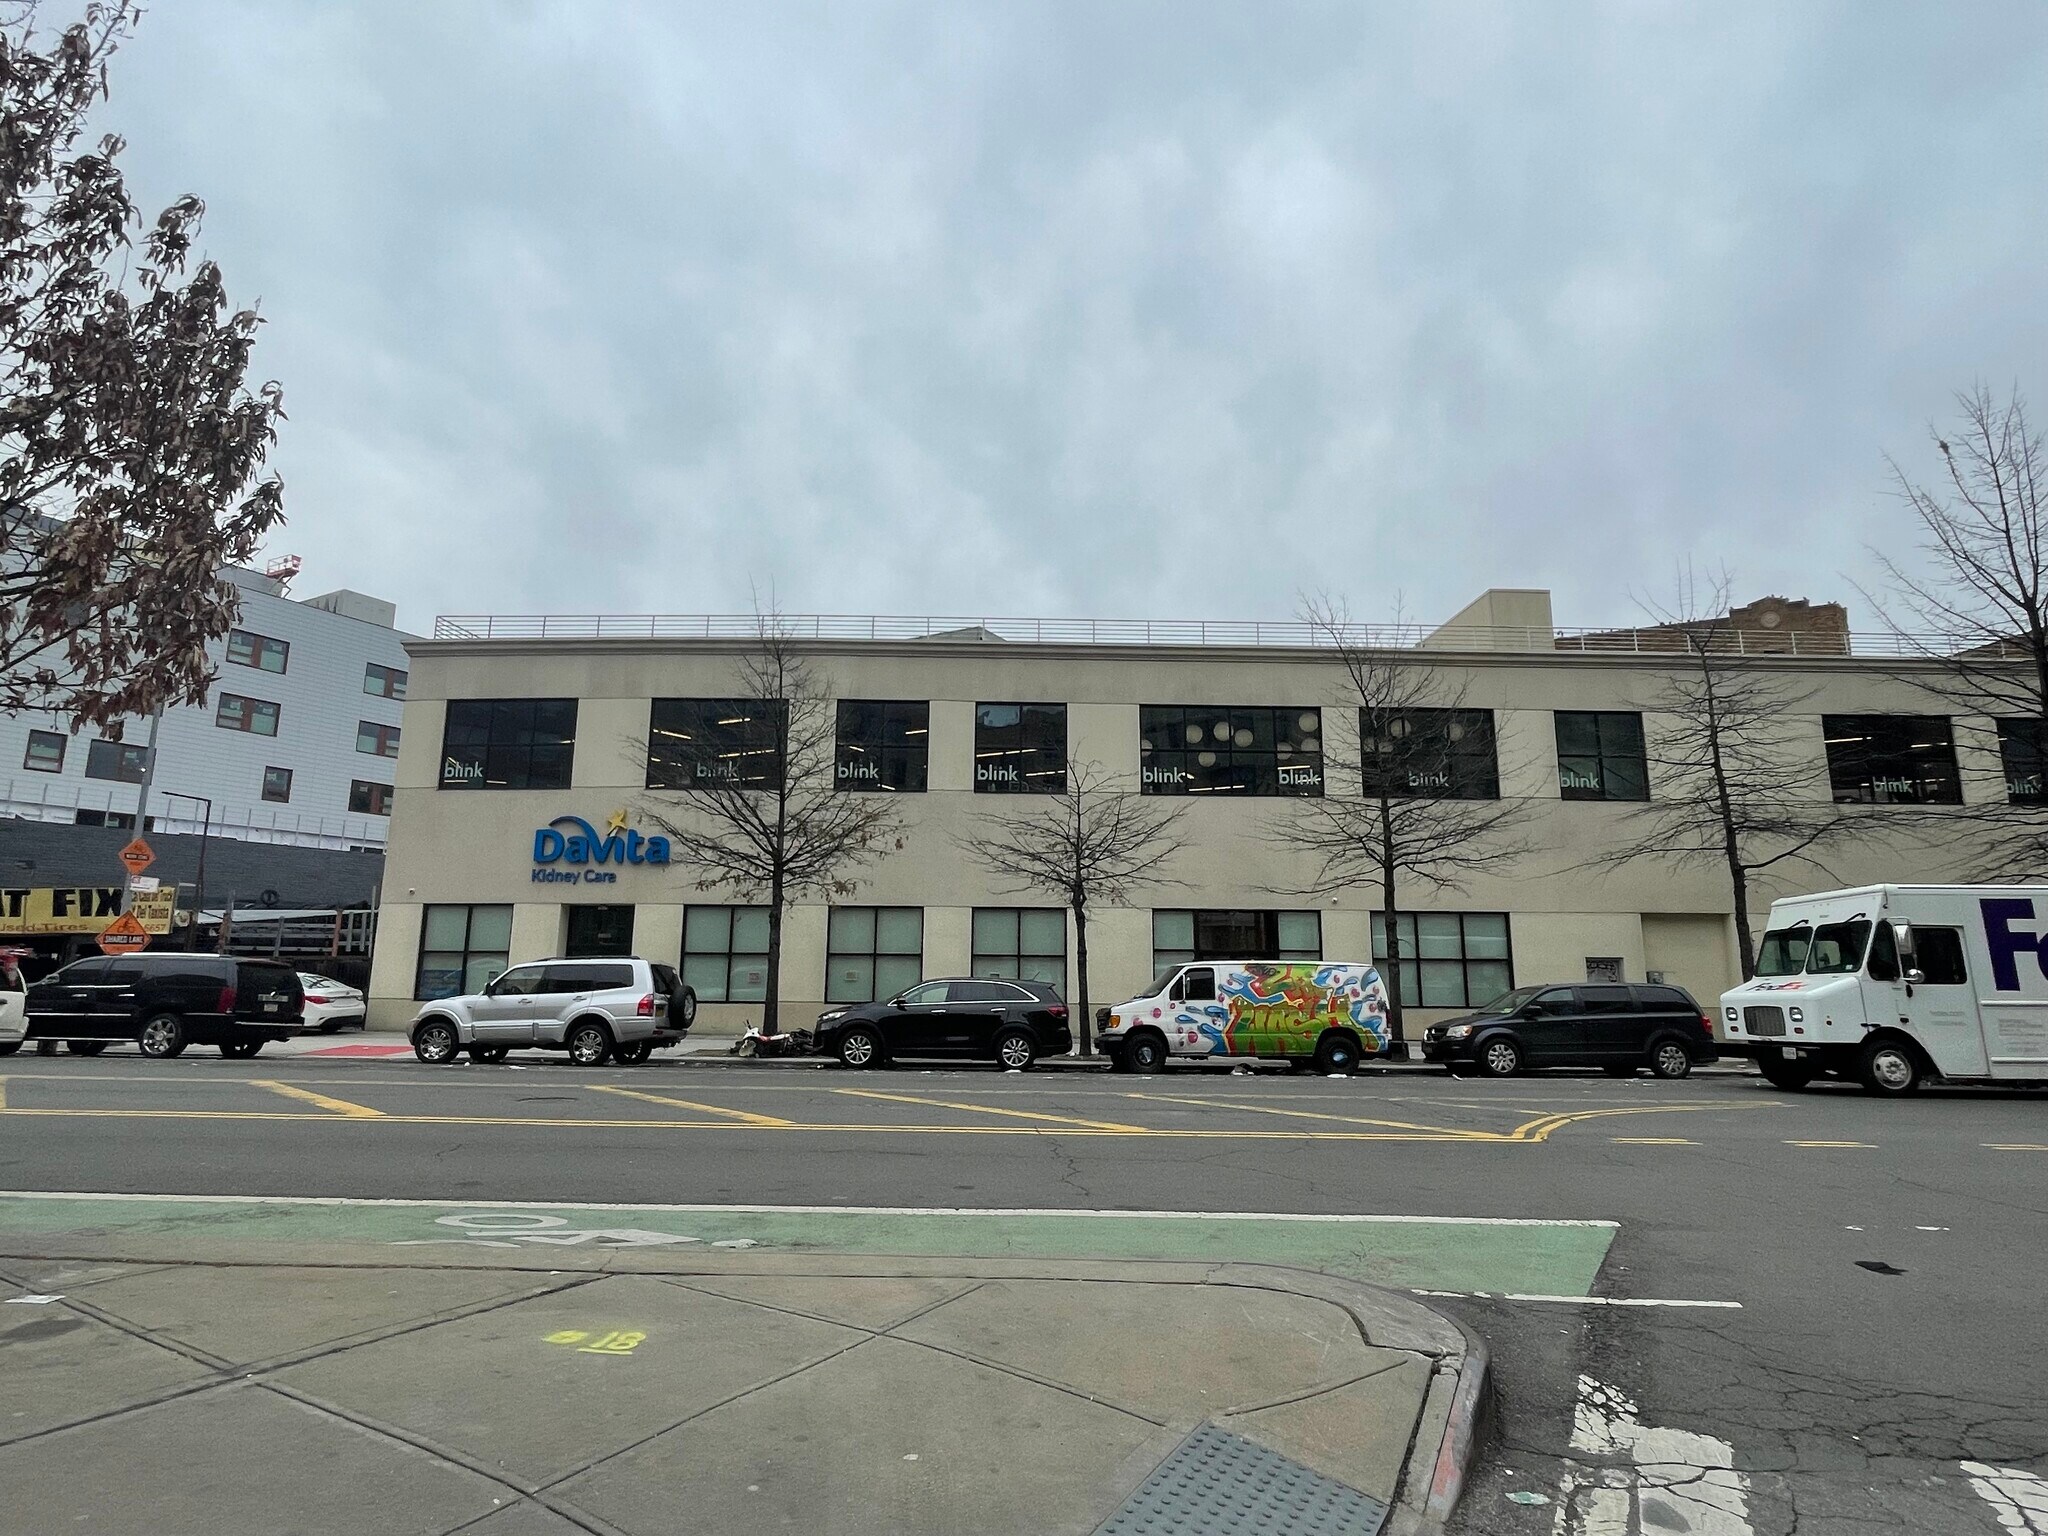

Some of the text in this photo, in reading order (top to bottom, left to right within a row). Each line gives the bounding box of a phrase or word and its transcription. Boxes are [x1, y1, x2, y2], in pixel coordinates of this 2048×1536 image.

[444, 761, 483, 777] blink
[838, 761, 879, 778] blink
[977, 764, 1018, 780] blink
[1142, 766, 1185, 783] blink
[1279, 768, 1319, 785] blink
[1409, 770, 1449, 786] blink
[1560, 771, 1600, 788] blink
[1872, 776, 1912, 792] blink
[533, 815, 671, 864] DaVita
[531, 868, 617, 884] Kidney Care
[52, 888, 123, 917] FIX
[1979, 898, 2048, 992] F
